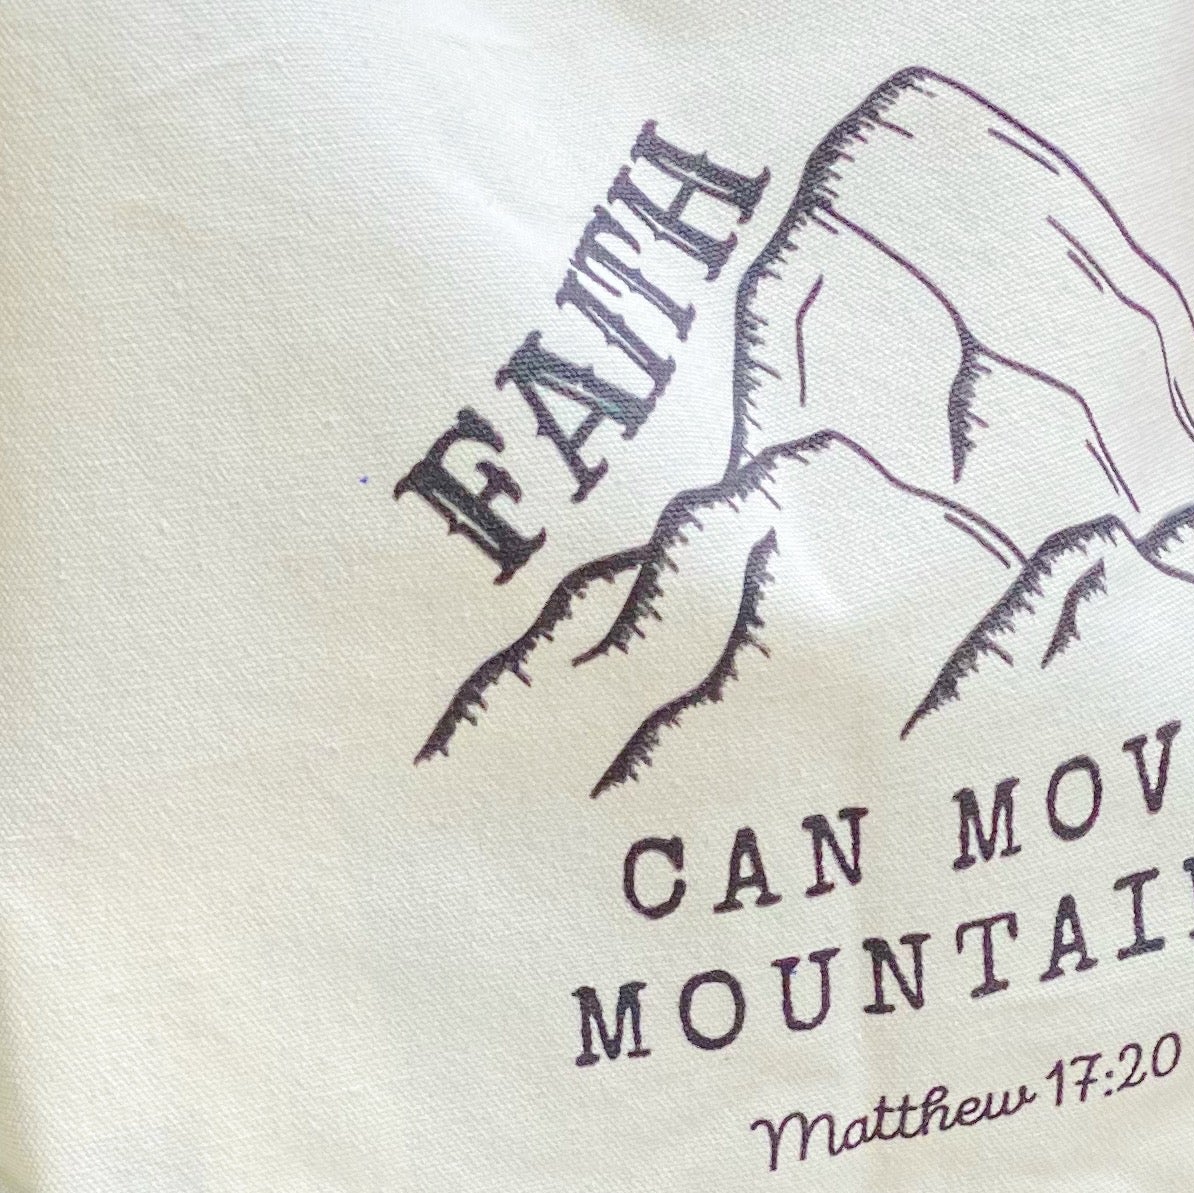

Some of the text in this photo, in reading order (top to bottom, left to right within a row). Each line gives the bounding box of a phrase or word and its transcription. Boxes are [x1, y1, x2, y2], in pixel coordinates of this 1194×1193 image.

[393, 119, 771, 586] FAITH
[622, 806, 870, 921] CAN
[749, 1031, 1183, 1172] Matthew 17:20
